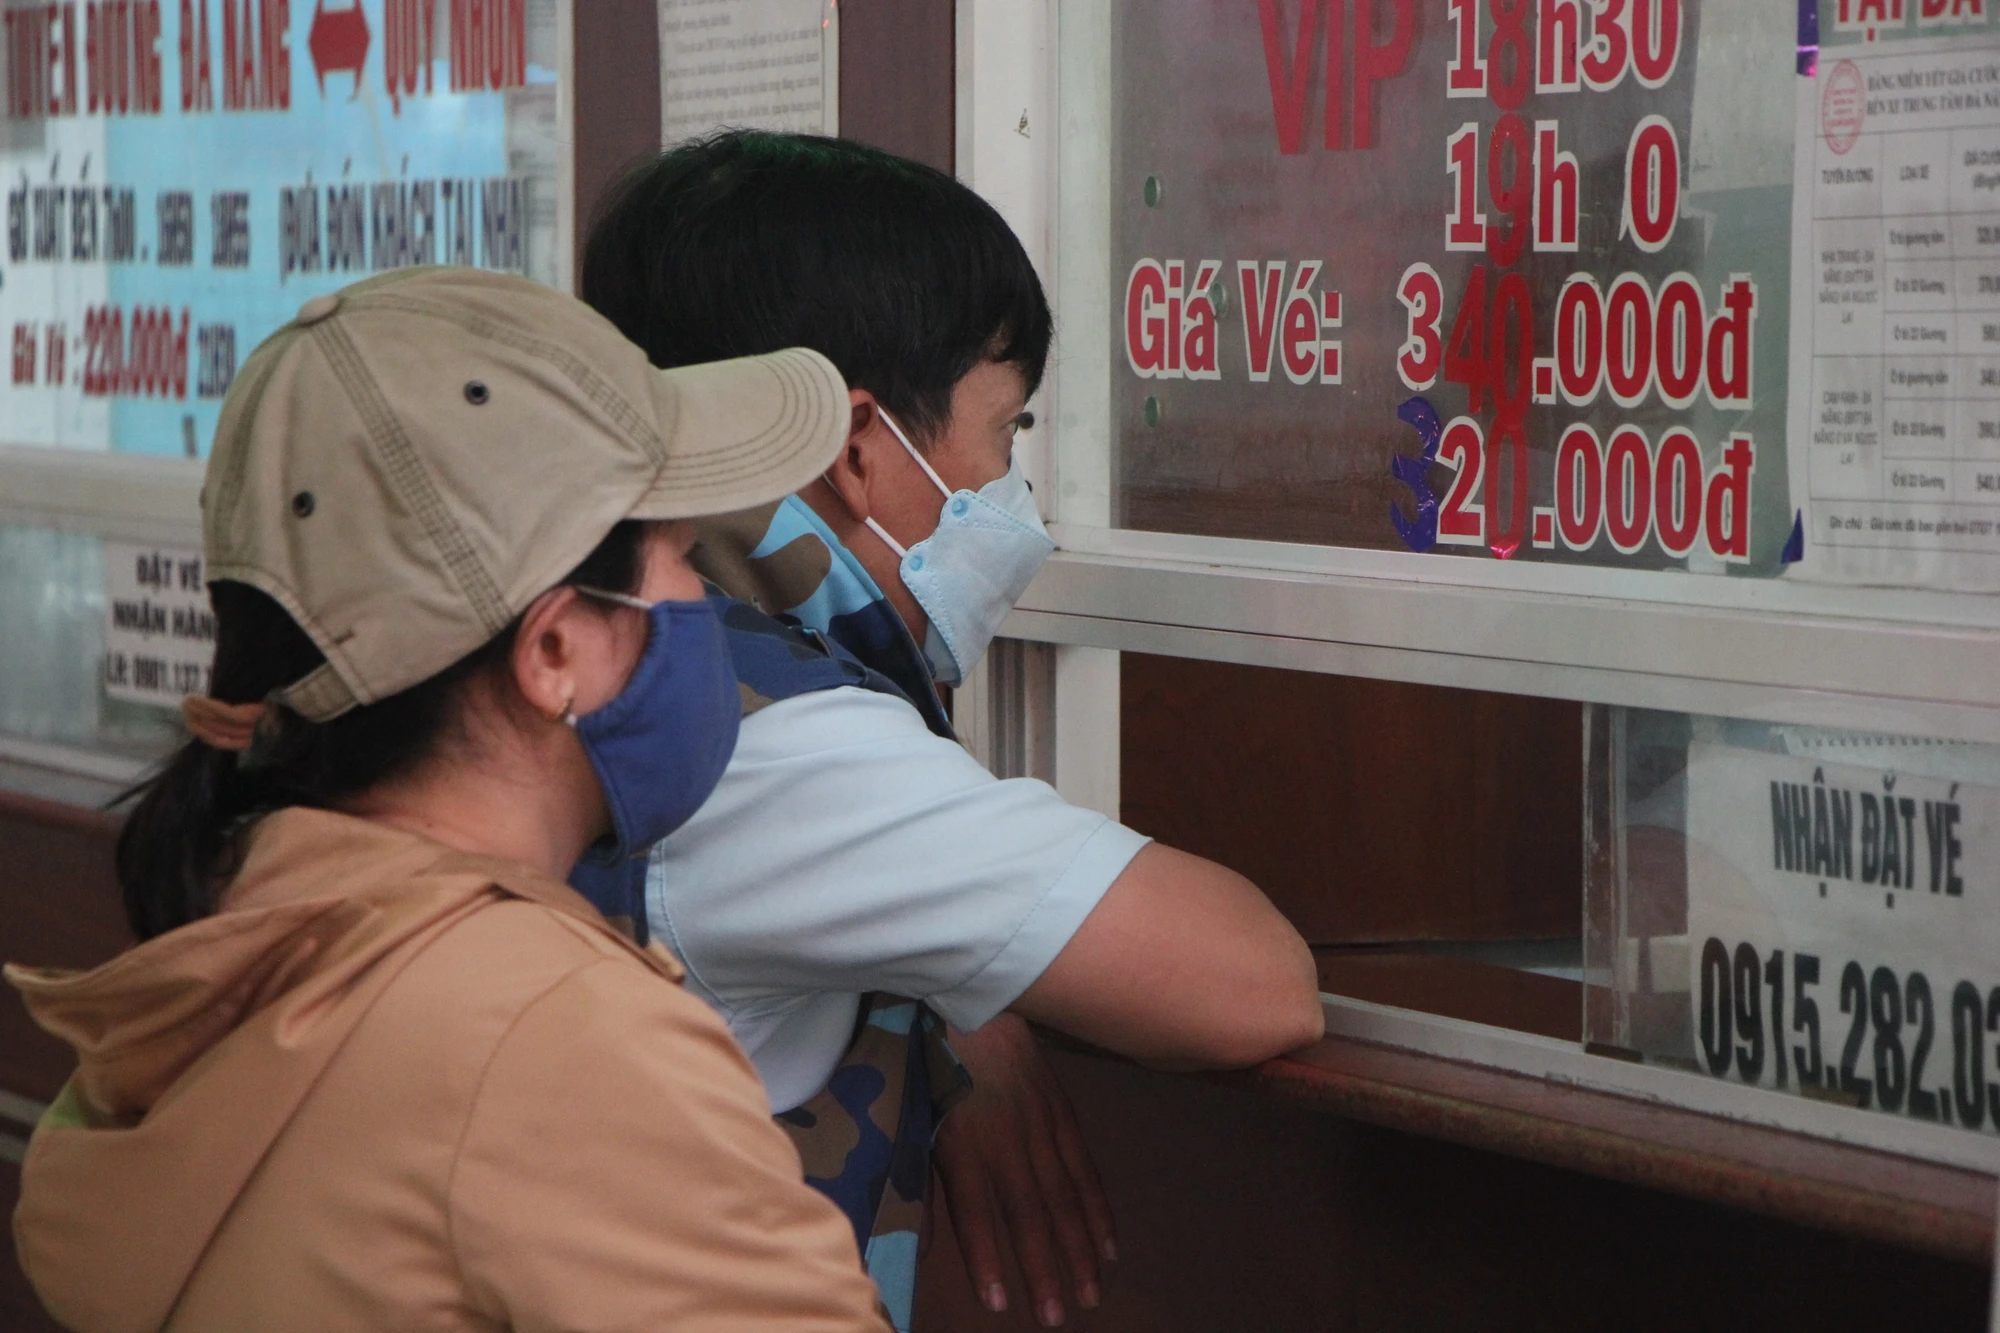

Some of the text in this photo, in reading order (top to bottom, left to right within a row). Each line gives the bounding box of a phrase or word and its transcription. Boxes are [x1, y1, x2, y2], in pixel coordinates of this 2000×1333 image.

[1256, 0, 1424, 155] VIP
[1446, 0, 1683, 110] 18h30
[1125, 258, 1757, 420] Giá Vé: 340.000đ
[1771, 767, 1964, 908] NHẬN ĐẶT VÉ
